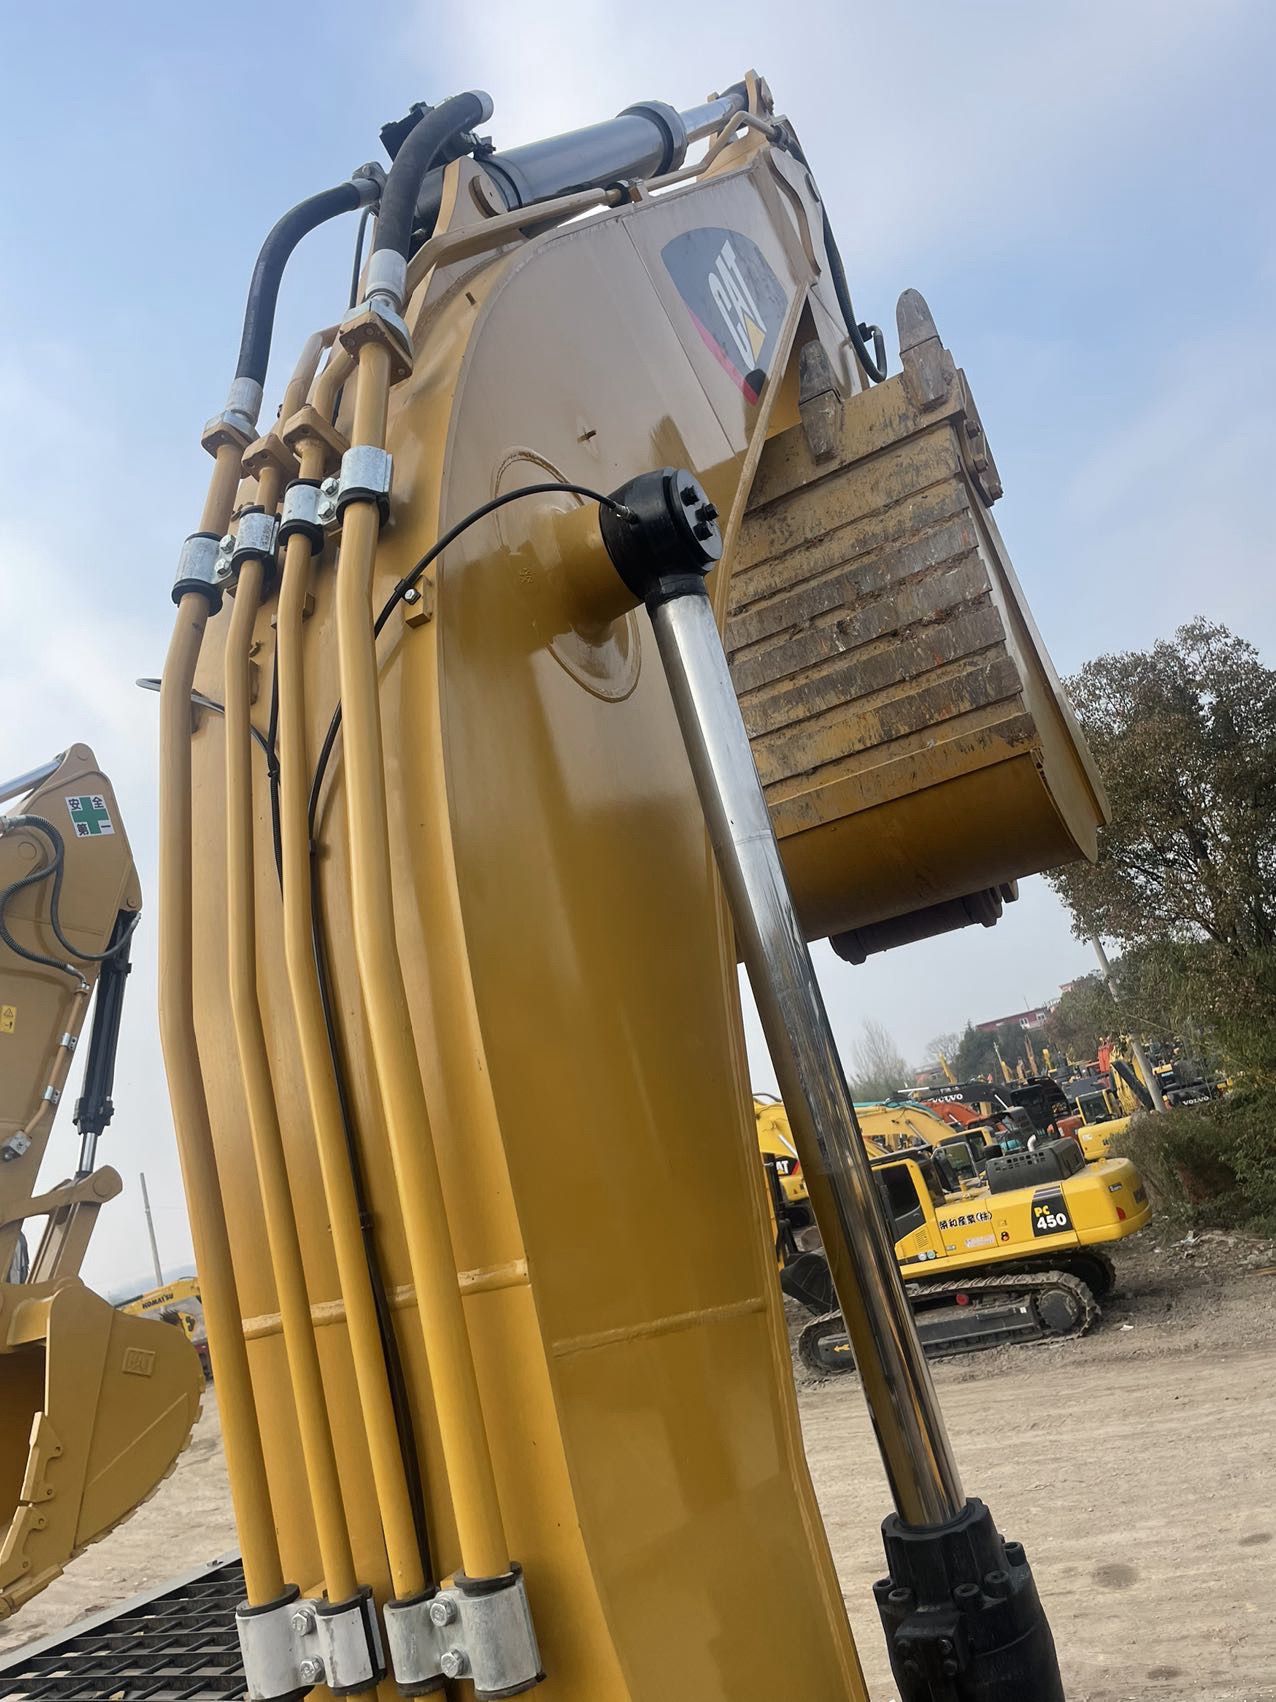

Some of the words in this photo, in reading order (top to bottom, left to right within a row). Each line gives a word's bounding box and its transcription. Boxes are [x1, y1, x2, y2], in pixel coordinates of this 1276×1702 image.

[708, 240, 767, 370] CAT
[68, 797, 104, 810] 安全
[1182, 1095, 1210, 1106] VOLVO
[775, 1160, 789, 1175] AT
[1033, 1204, 1051, 1217] PC
[1036, 1212, 1067, 1230] 450
[142, 1293, 174, 1309] KOMATSU
